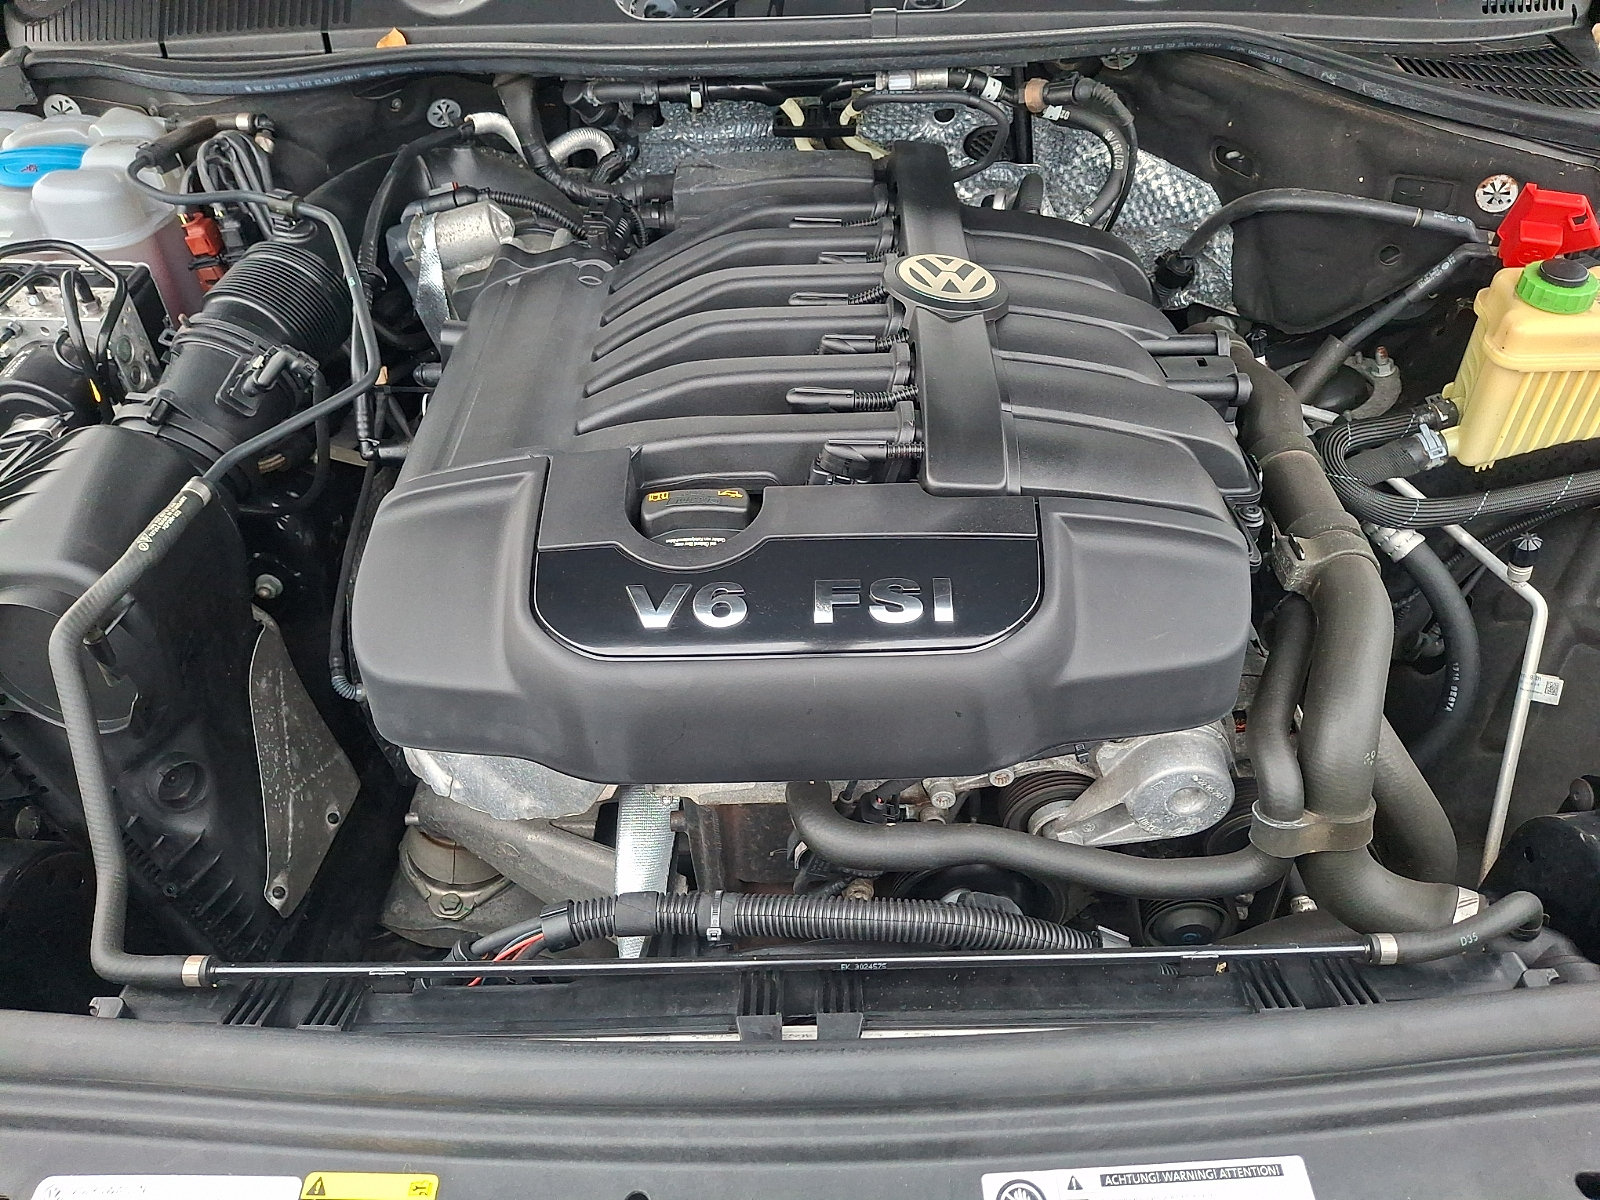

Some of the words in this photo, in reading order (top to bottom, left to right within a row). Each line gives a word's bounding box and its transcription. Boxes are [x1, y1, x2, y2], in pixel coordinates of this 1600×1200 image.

[626, 581, 748, 629] V6
[813, 576, 954, 624] FSI
[1460, 932, 1478, 947] D35
[1104, 1172, 1160, 1186] ACHTUNG!
[1162, 1168, 1218, 1183] WARNING!
[1219, 1164, 1280, 1180] ATTENTION!
